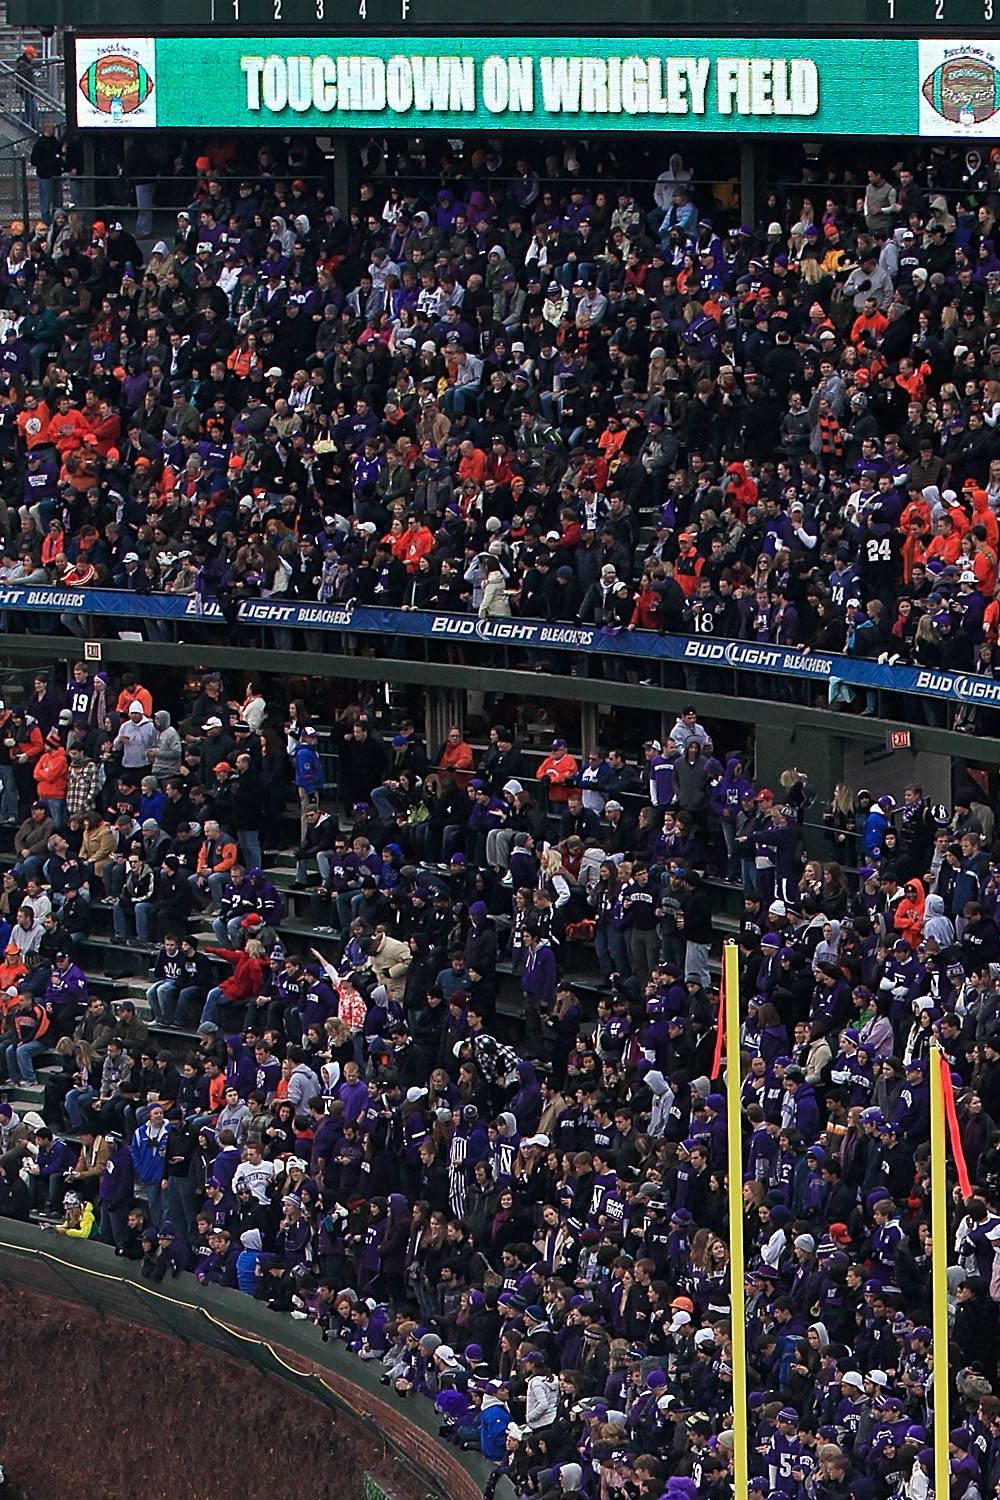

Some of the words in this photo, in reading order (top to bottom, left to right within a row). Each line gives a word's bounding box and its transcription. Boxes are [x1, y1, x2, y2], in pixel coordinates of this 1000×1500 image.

[233, 0, 239, 19] 1
[274, 0, 282, 20] 2
[316, 0, 324, 20] 3
[358, 0, 367, 20] 4
[402, 0, 410, 20] F
[887, 0, 895, 19] 1
[935, 0, 944, 20] 2
[984, 0, 993, 20] 3
[240, 54, 476, 113] TOUCHDOWN
[482, 54, 534, 114] ON
[539, 55, 711, 115] WRIGLEY
[716, 57, 819, 116] FIELD
[867, 538, 892, 563] 24
[27, 591, 86, 607] BLEACHERS
[831, 585, 844, 606] 14
[237, 604, 296, 621] LIGHT
[298, 608, 353, 626] BLEACHERS
[693, 612, 714, 633] 18
[431, 617, 474, 635] BUD
[483, 623, 538, 640] LIGHT
[684, 641, 725, 660] BUD
[731, 645, 782, 667] LIGHT
[783, 654, 833, 675] BLEACHERS
[916, 671, 954, 692] BUD
[72, 693, 89, 712] 19
[892, 732, 909, 747] EXIT
